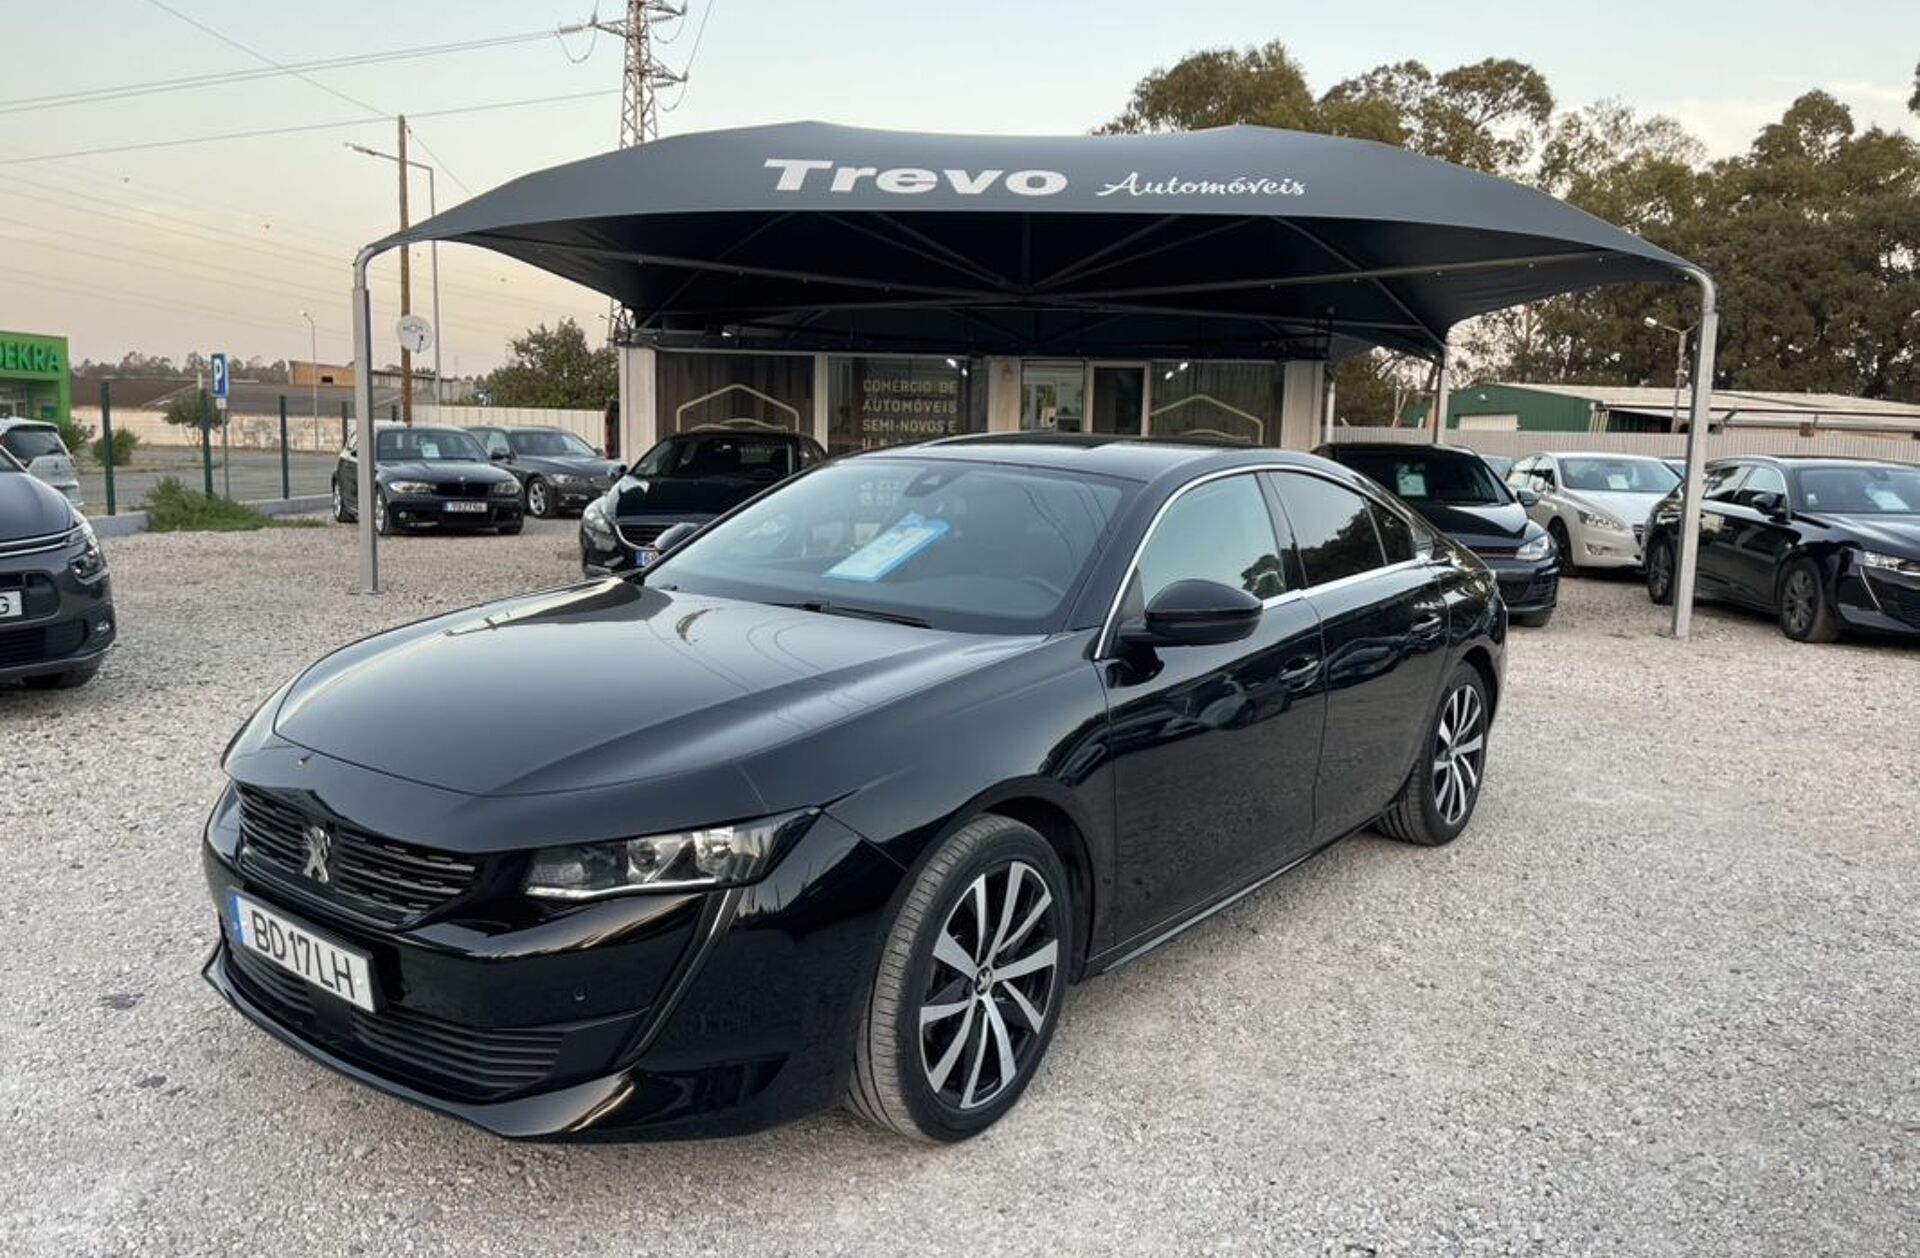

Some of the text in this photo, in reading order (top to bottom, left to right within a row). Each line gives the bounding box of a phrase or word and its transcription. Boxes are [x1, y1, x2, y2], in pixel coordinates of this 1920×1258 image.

[764, 158, 1305, 197] Trevo Automóveis
[213, 358, 223, 392] P
[939, 380, 957, 394] DE
